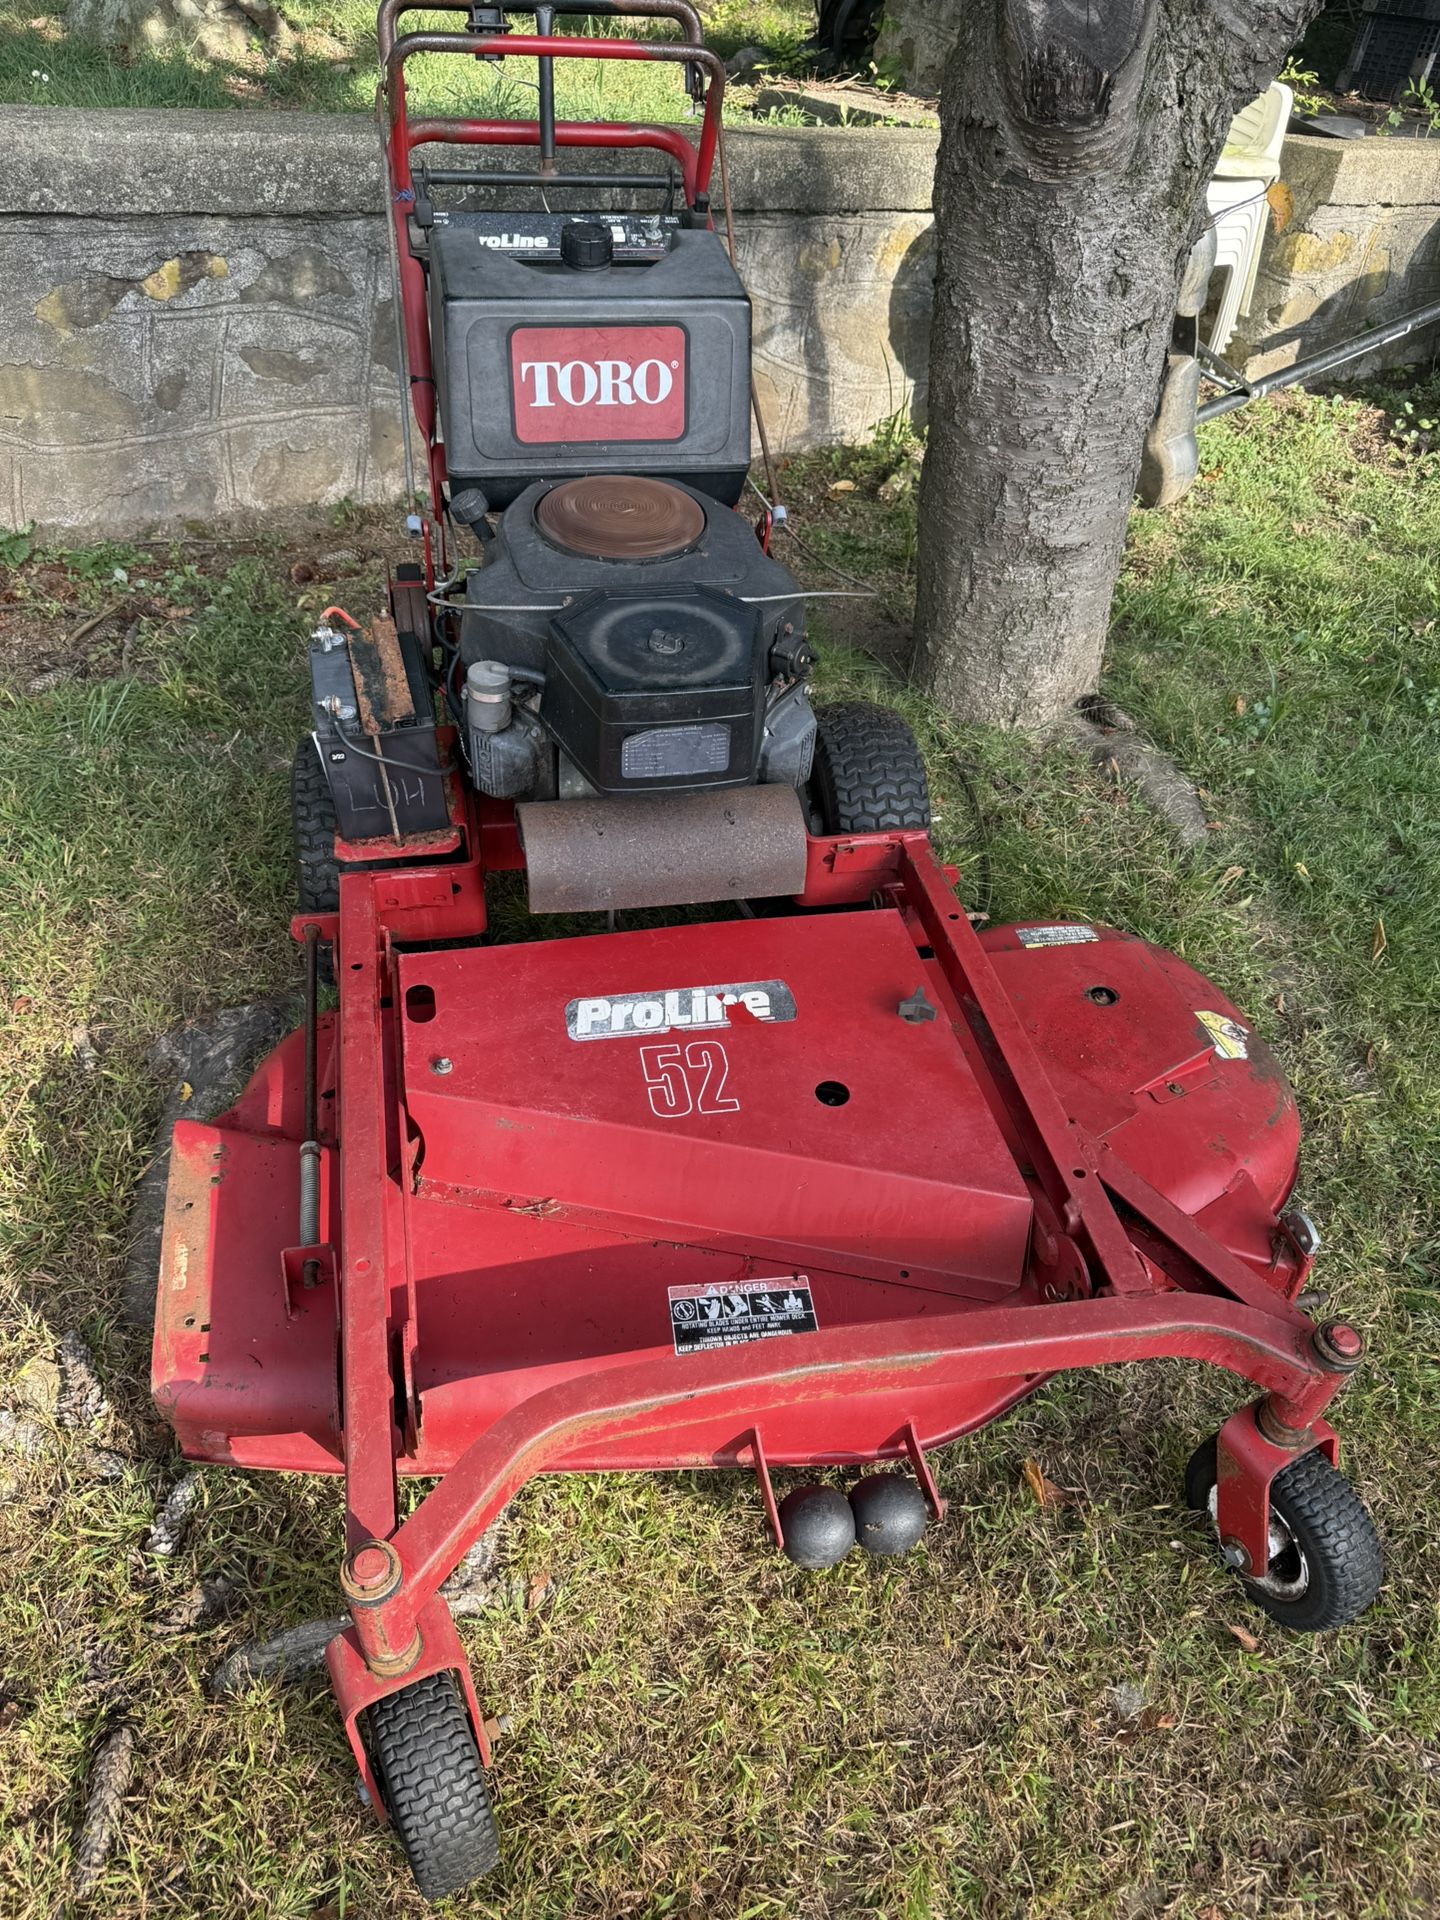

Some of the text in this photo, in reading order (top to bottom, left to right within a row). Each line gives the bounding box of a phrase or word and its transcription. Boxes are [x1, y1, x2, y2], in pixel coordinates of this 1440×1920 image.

[479, 233, 549, 247] roLine
[640, 1040, 740, 1118] 52
[681, 1320, 708, 1330] ROTATING
[709, 1318, 730, 1328] BLADES
[731, 1317, 749, 1326] UNDER
[750, 1315, 769, 1324] ENTIRE
[771, 1313, 790, 1322] MOWER
[707, 1326, 721, 1334] KEEP
[722, 1325, 740, 1333] HANDS
[752, 1322, 765, 1330] FEET
[699, 1335, 723, 1344] THROWN
[724, 1333, 748, 1342] OBJECTS
[749, 1331, 760, 1339] ARE
[761, 1328, 793, 1338] DANGEROUS
[678, 1345, 693, 1354] KEEP
[694, 1341, 725, 1352] DEFLECTOR
